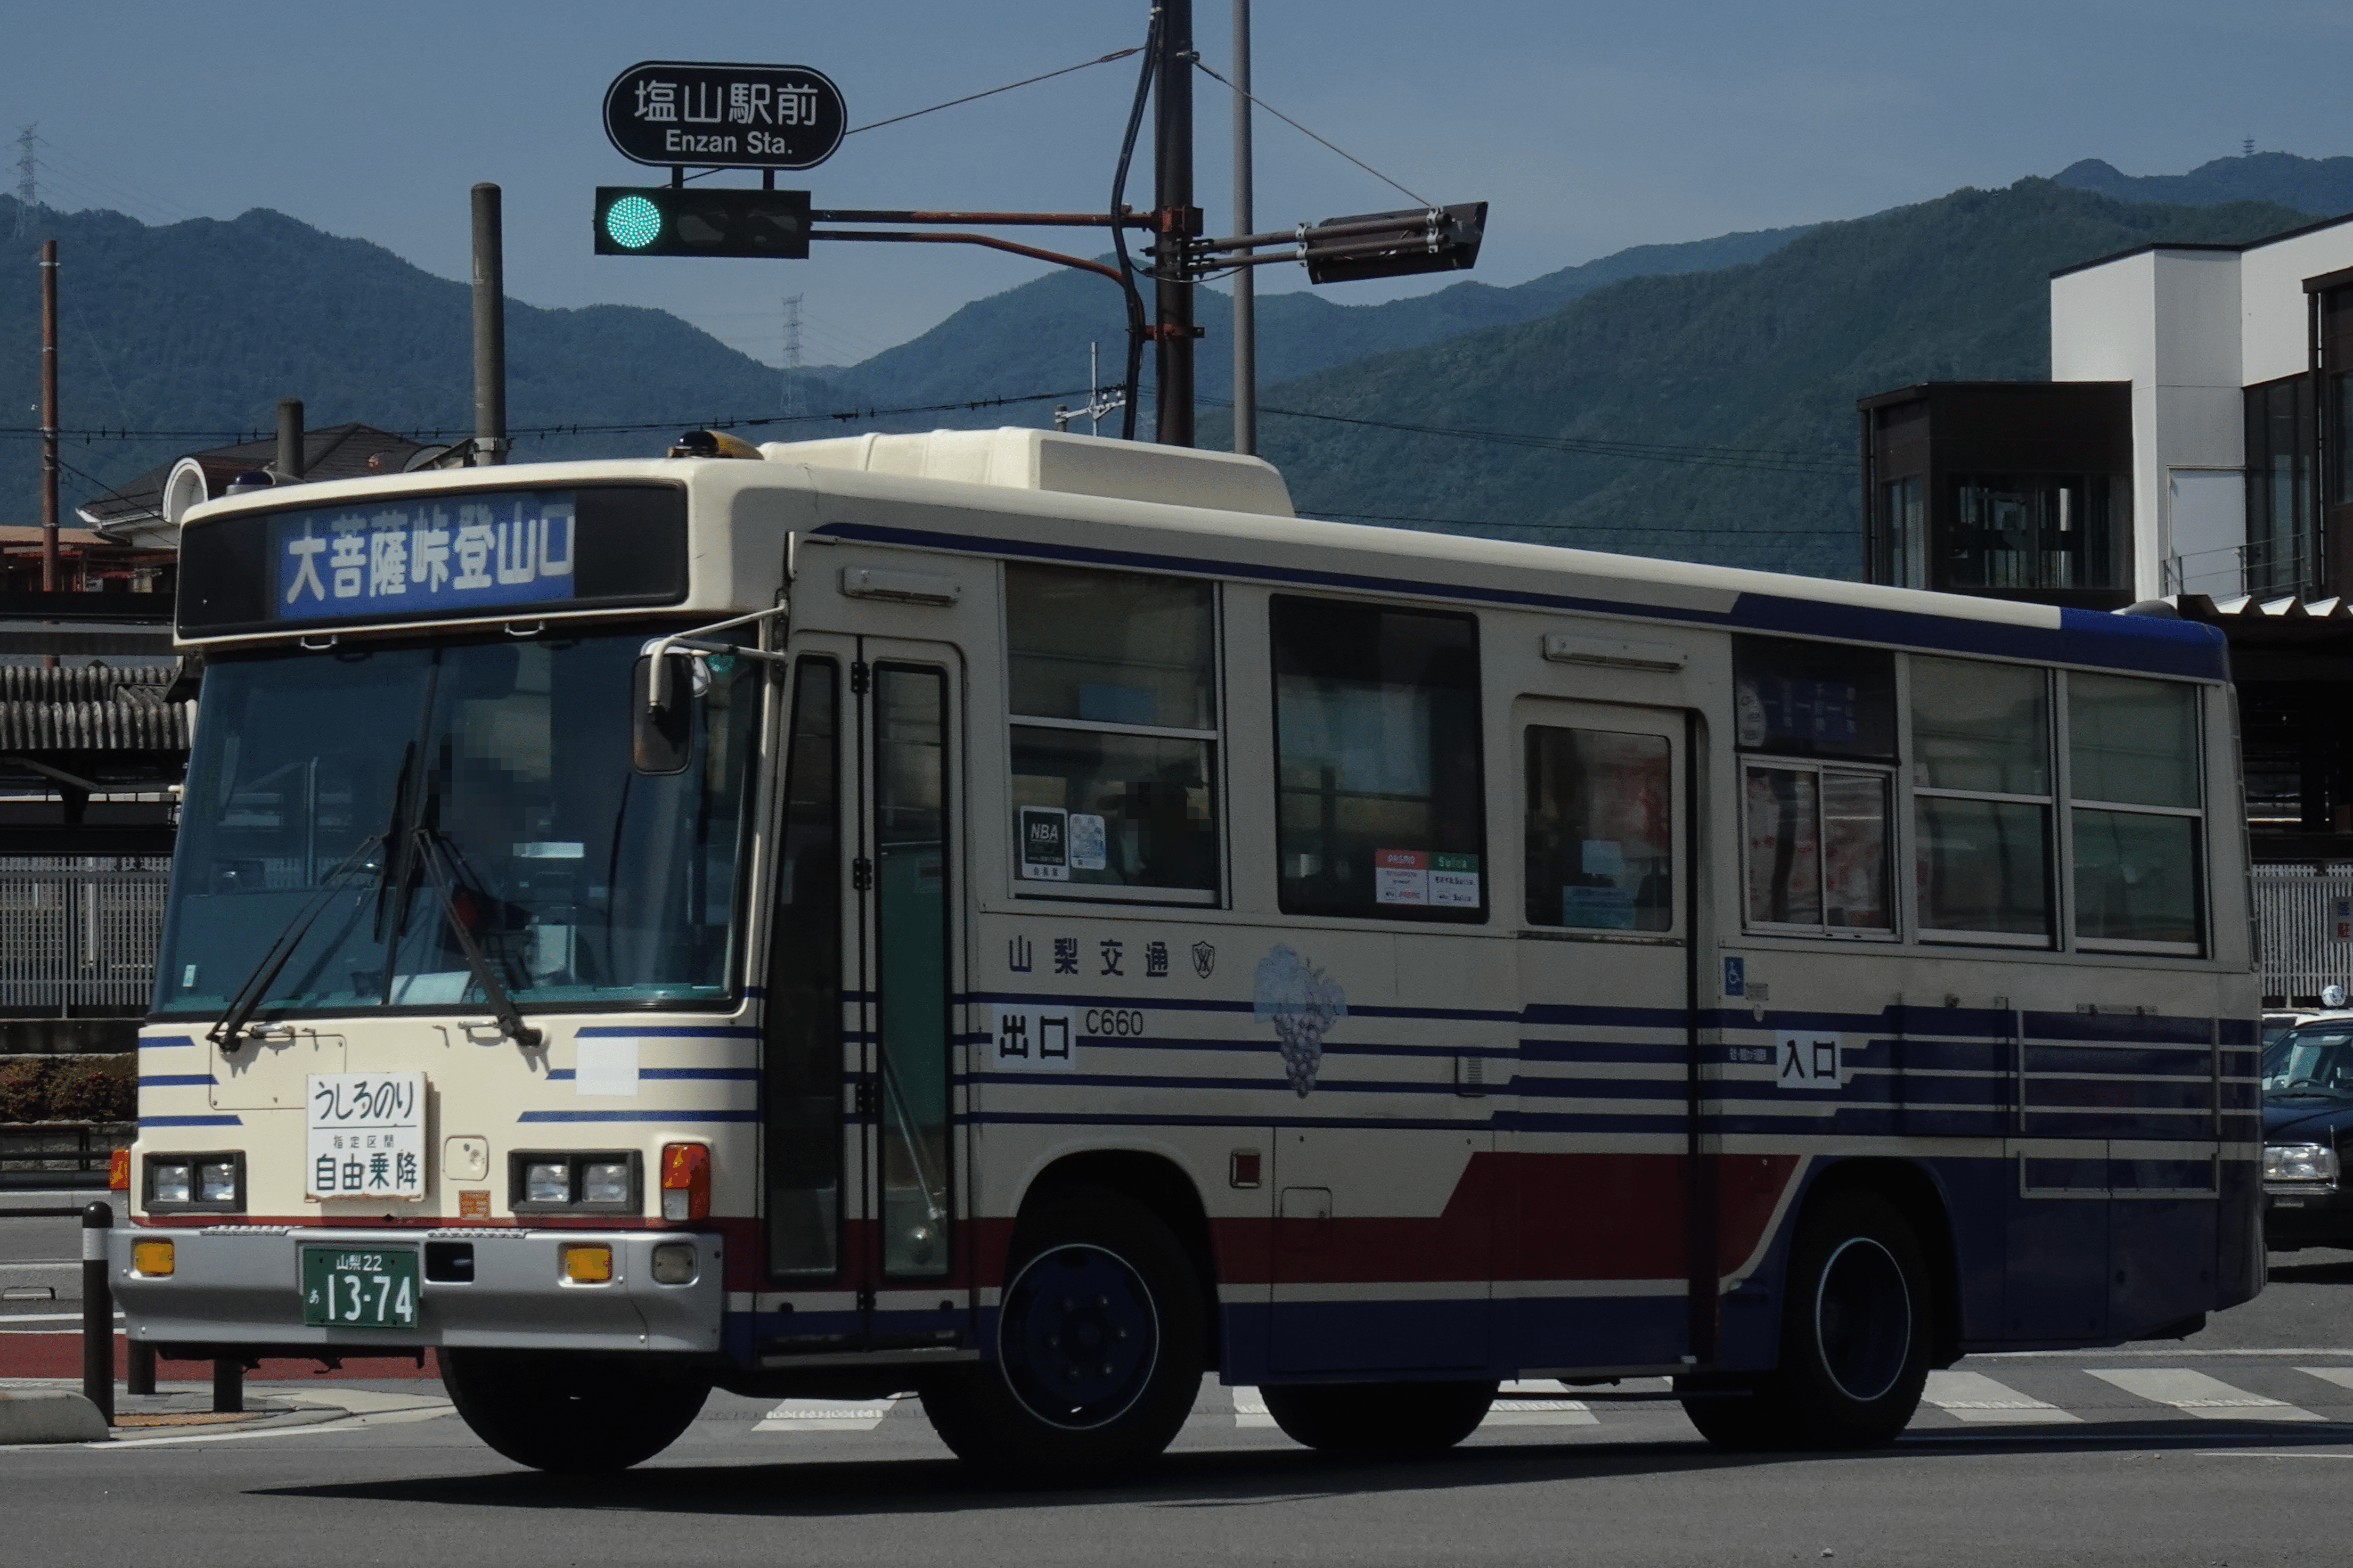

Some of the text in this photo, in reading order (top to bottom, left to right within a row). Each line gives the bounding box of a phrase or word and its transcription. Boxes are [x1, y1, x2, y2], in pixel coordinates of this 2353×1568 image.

[634, 80, 818, 126] 塩山駅前
[665, 129, 793, 154] Enzan Sta.
[286, 502, 575, 604] 大菩薩峠登山口
[1031, 823, 1059, 841] NBA
[1009, 935, 1169, 978] 山梨交通
[1000, 1014, 1069, 1060] 出口
[1085, 1009, 1143, 1036] C660
[1782, 1039, 1836, 1079] 入口
[315, 1080, 414, 1120] うしろのり
[333, 1134, 394, 1149] 指定区間
[316, 1152, 417, 1190] 自由乗降
